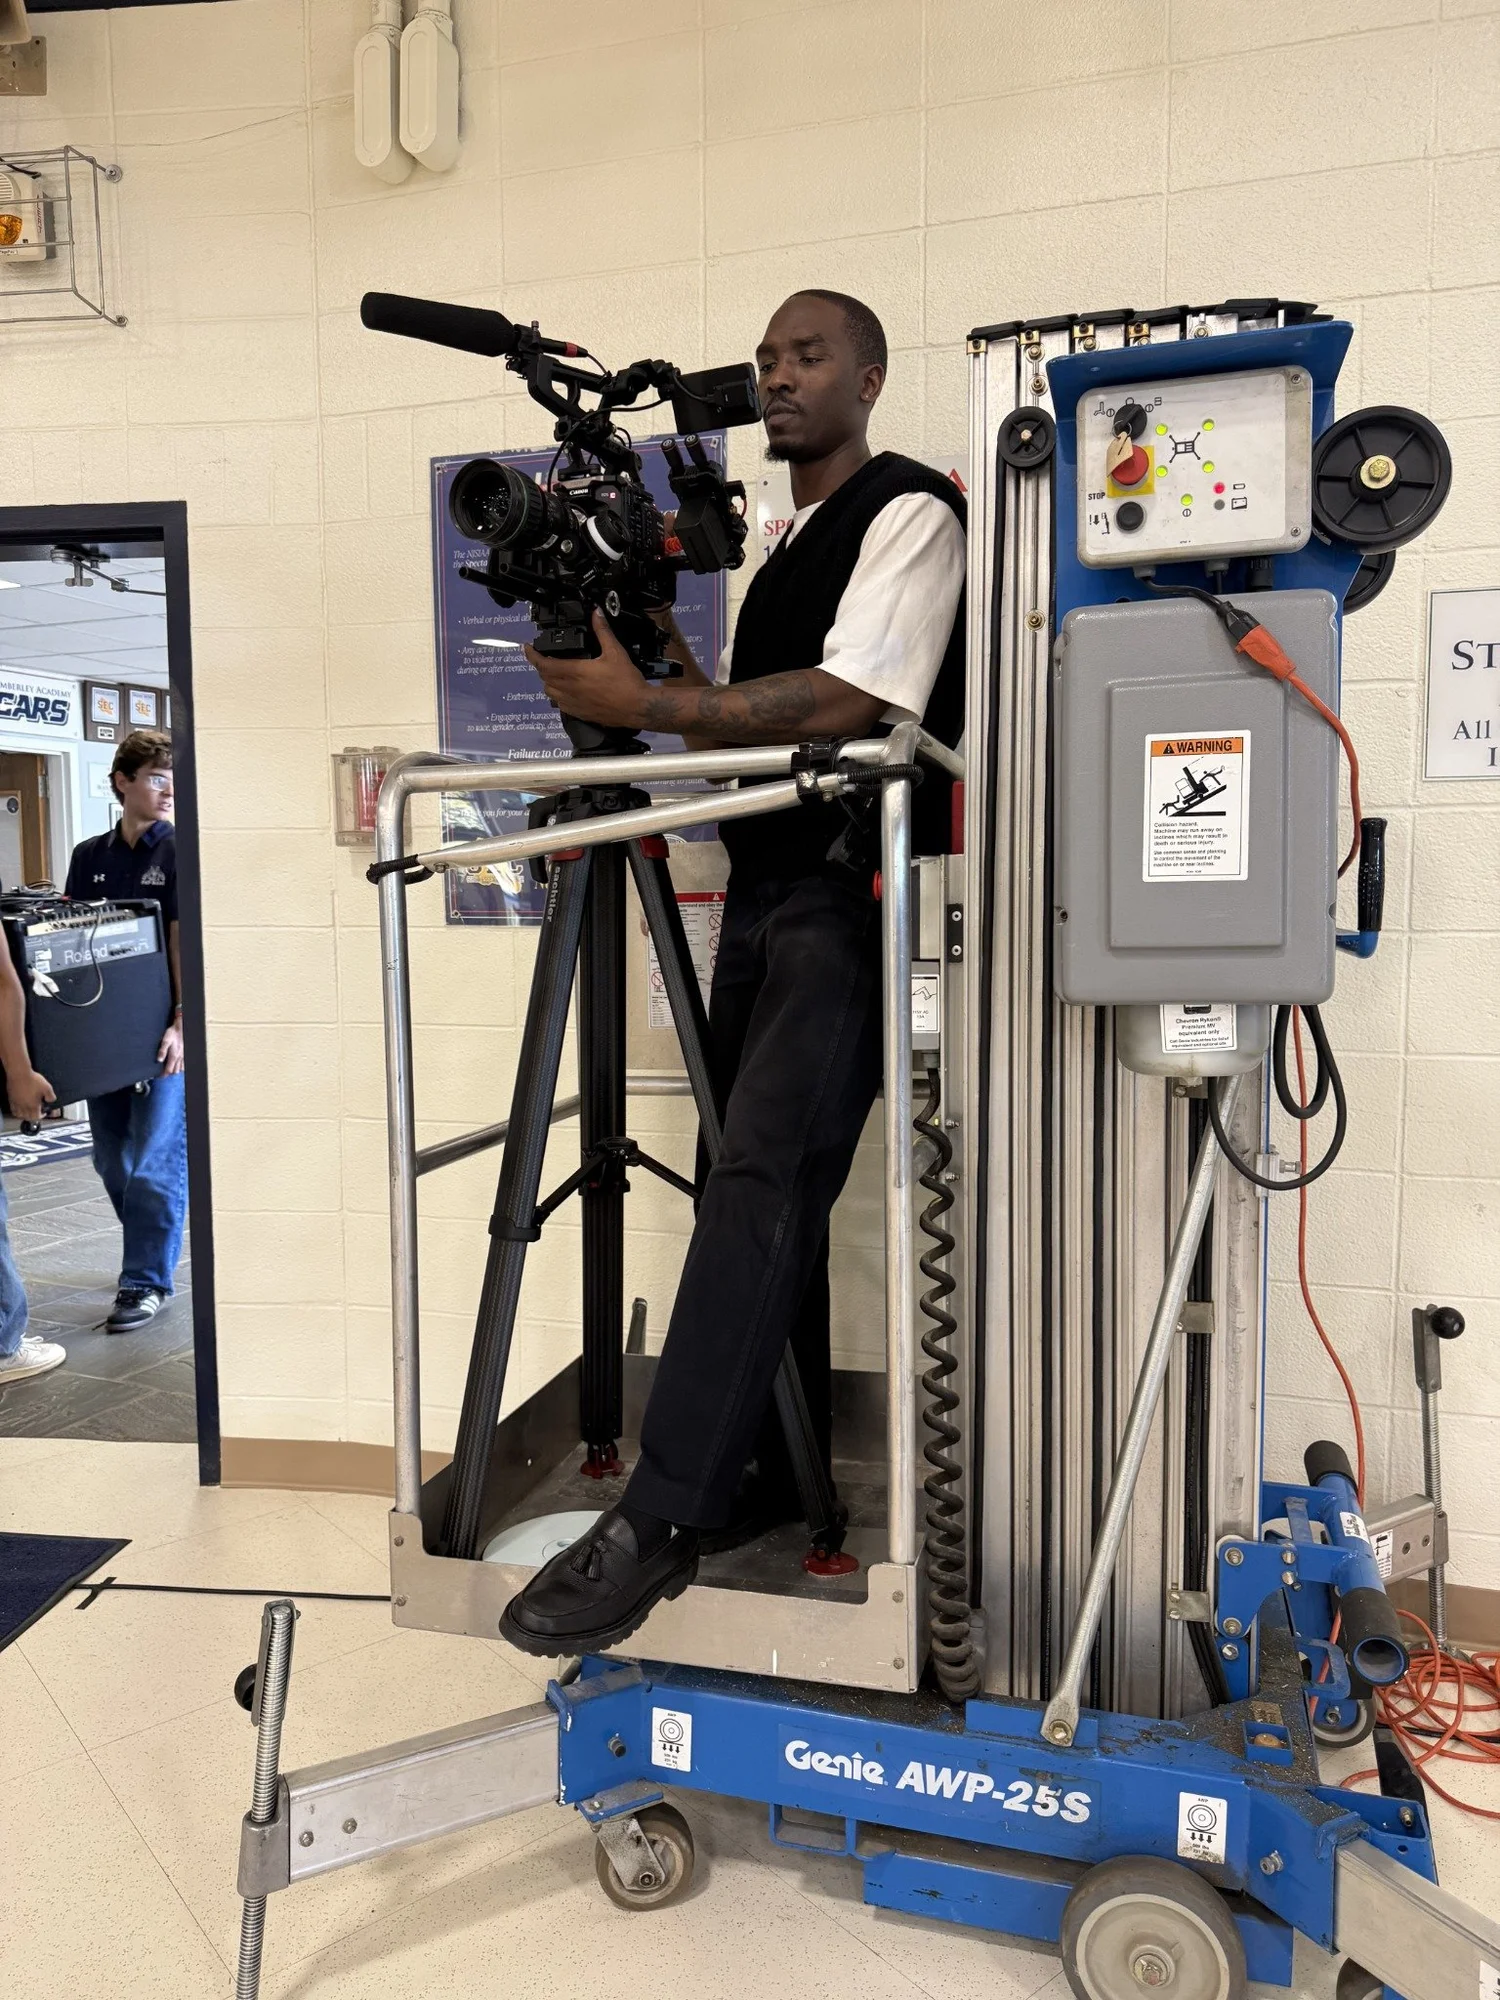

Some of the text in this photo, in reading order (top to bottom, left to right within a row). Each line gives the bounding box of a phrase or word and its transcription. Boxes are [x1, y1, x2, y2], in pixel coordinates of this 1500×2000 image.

[569, 488, 589, 496] Canon
[1088, 491, 1106, 501] STOP
[462, 615, 485, 625] Verbal
[493, 613, 521, 625] physical
[456, 666, 479, 676] during
[487, 664, 504, 675] after
[506, 692, 535, 703] Entering
[490, 712, 521, 724] Engaging
[1452, 719, 1492, 741] All
[1176, 739, 1233, 753] WARNING
[508, 748, 541, 760] Failure
[541, 749, 551, 760] to
[483, 808, 496, 818] you
[496, 807, 507, 818] for
[507, 808, 523, 819] your
[64, 944, 108, 965] Roland
[784, 1739, 1093, 1823] Genie AWP-25S
